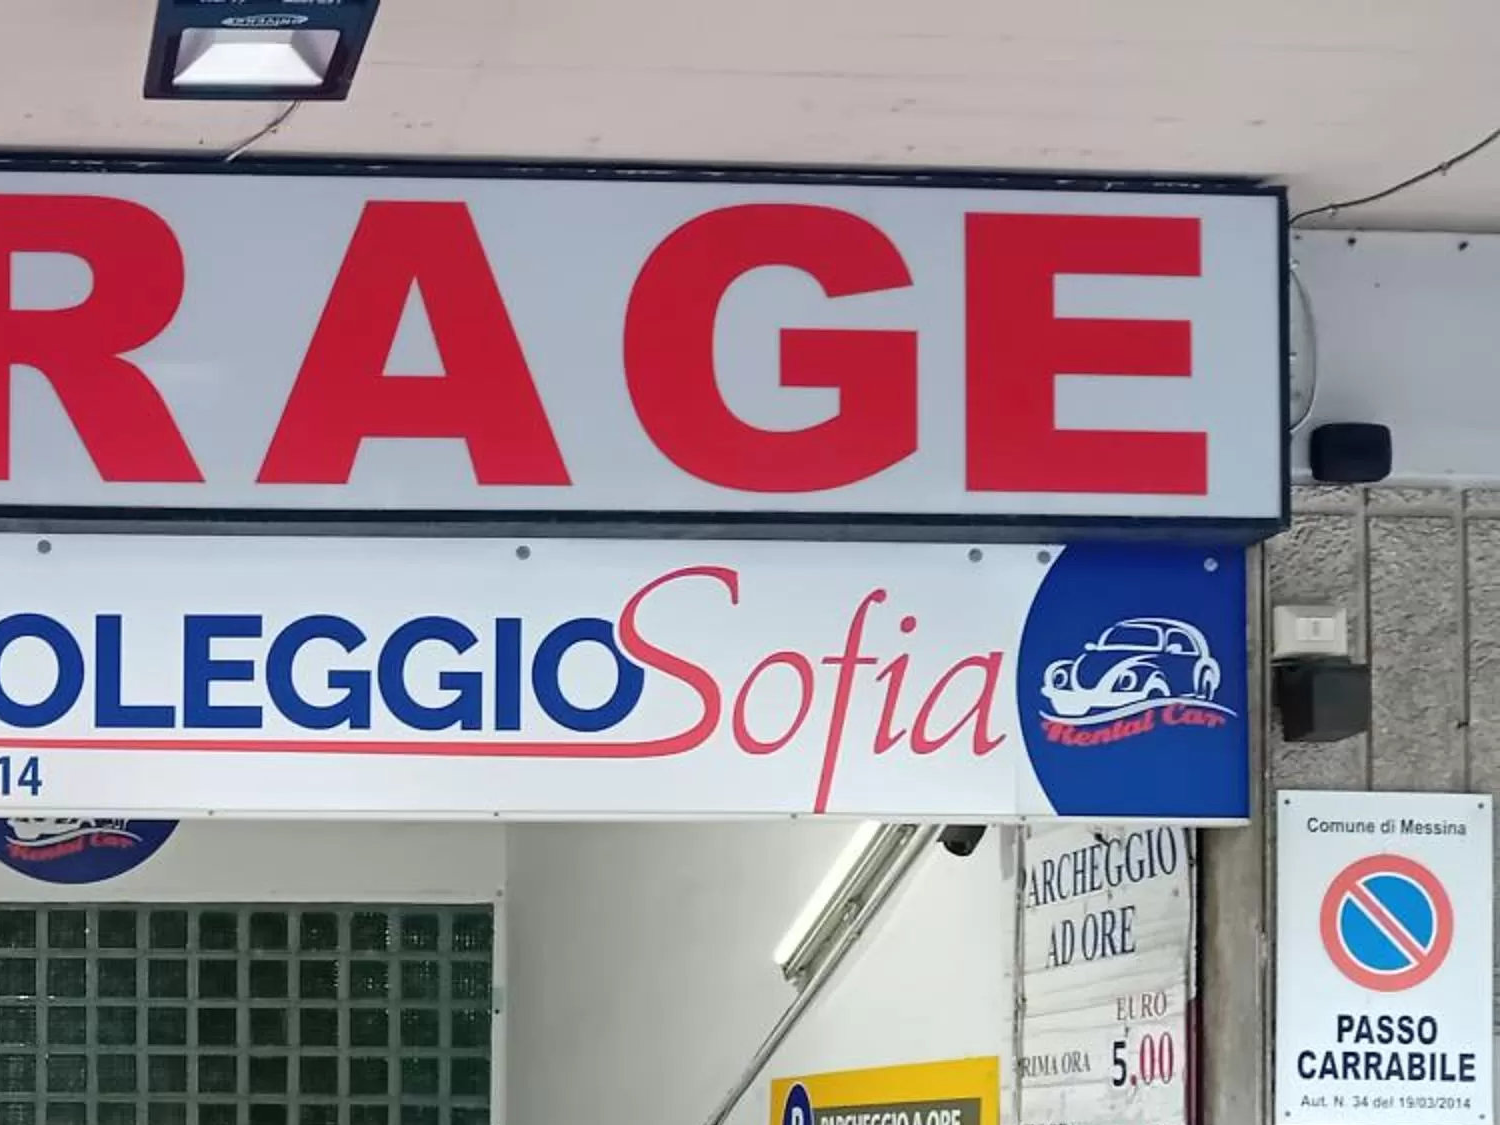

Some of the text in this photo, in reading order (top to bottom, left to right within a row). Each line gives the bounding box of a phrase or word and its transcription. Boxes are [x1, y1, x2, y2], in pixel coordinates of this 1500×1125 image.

[616, 565, 1006, 813] Sofia
[1041, 702, 1226, 746] Rental Car
[1306, 816, 1467, 836] Comune di Messina
[1081, 904, 1136, 962] ORE
[1336, 1013, 1439, 1046] PASSO
[1061, 1050, 1092, 1075] ORA
[1112, 1031, 1174, 1097] 5,00
[1296, 1049, 1477, 1083] CARRABILE
[1373, 1096, 1394, 1109] del
[1399, 1096, 1472, 1109] 19/03/2014
